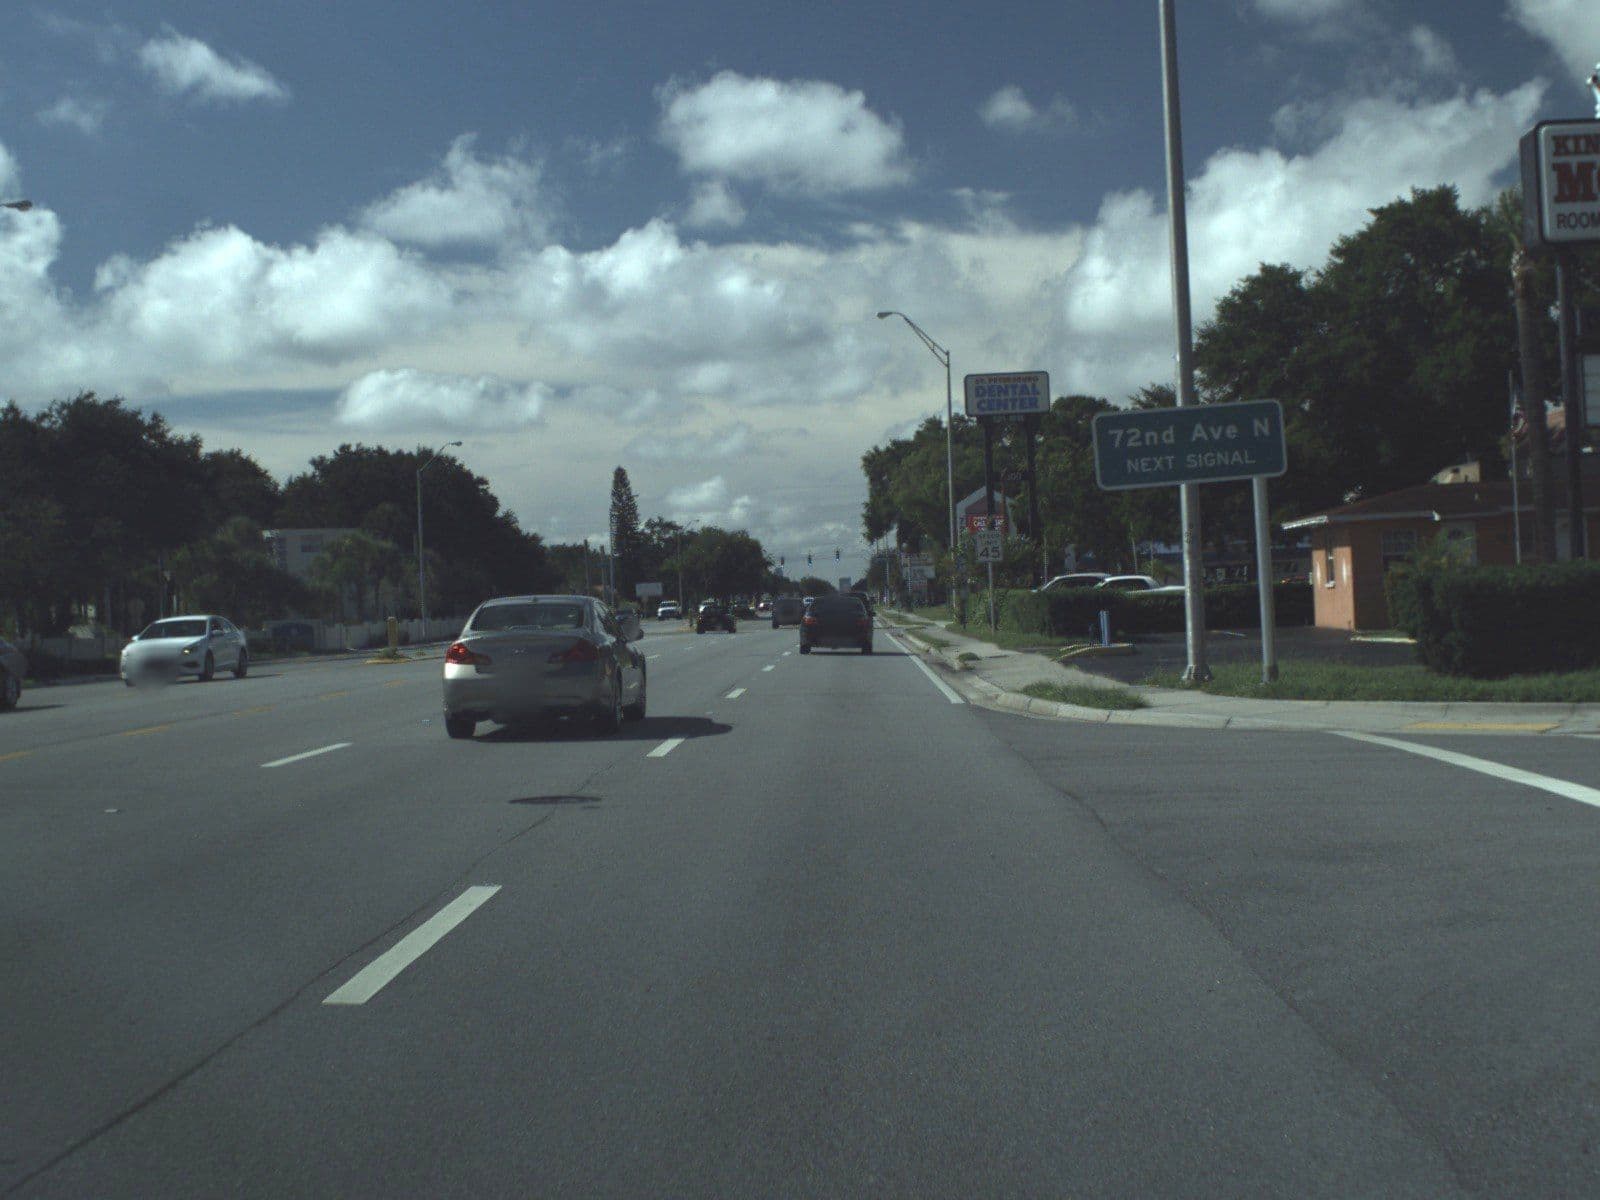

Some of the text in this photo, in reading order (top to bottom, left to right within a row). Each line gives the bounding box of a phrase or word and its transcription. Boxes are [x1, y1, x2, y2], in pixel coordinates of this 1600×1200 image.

[1552, 161, 1600, 204] M
[974, 382, 1041, 398] DENTAL
[976, 396, 1040, 412] CENTER
[1107, 416, 1271, 449] 72nd Ave N
[1126, 450, 1257, 473] NEXT SIGNAL
[979, 546, 1001, 559] 45
